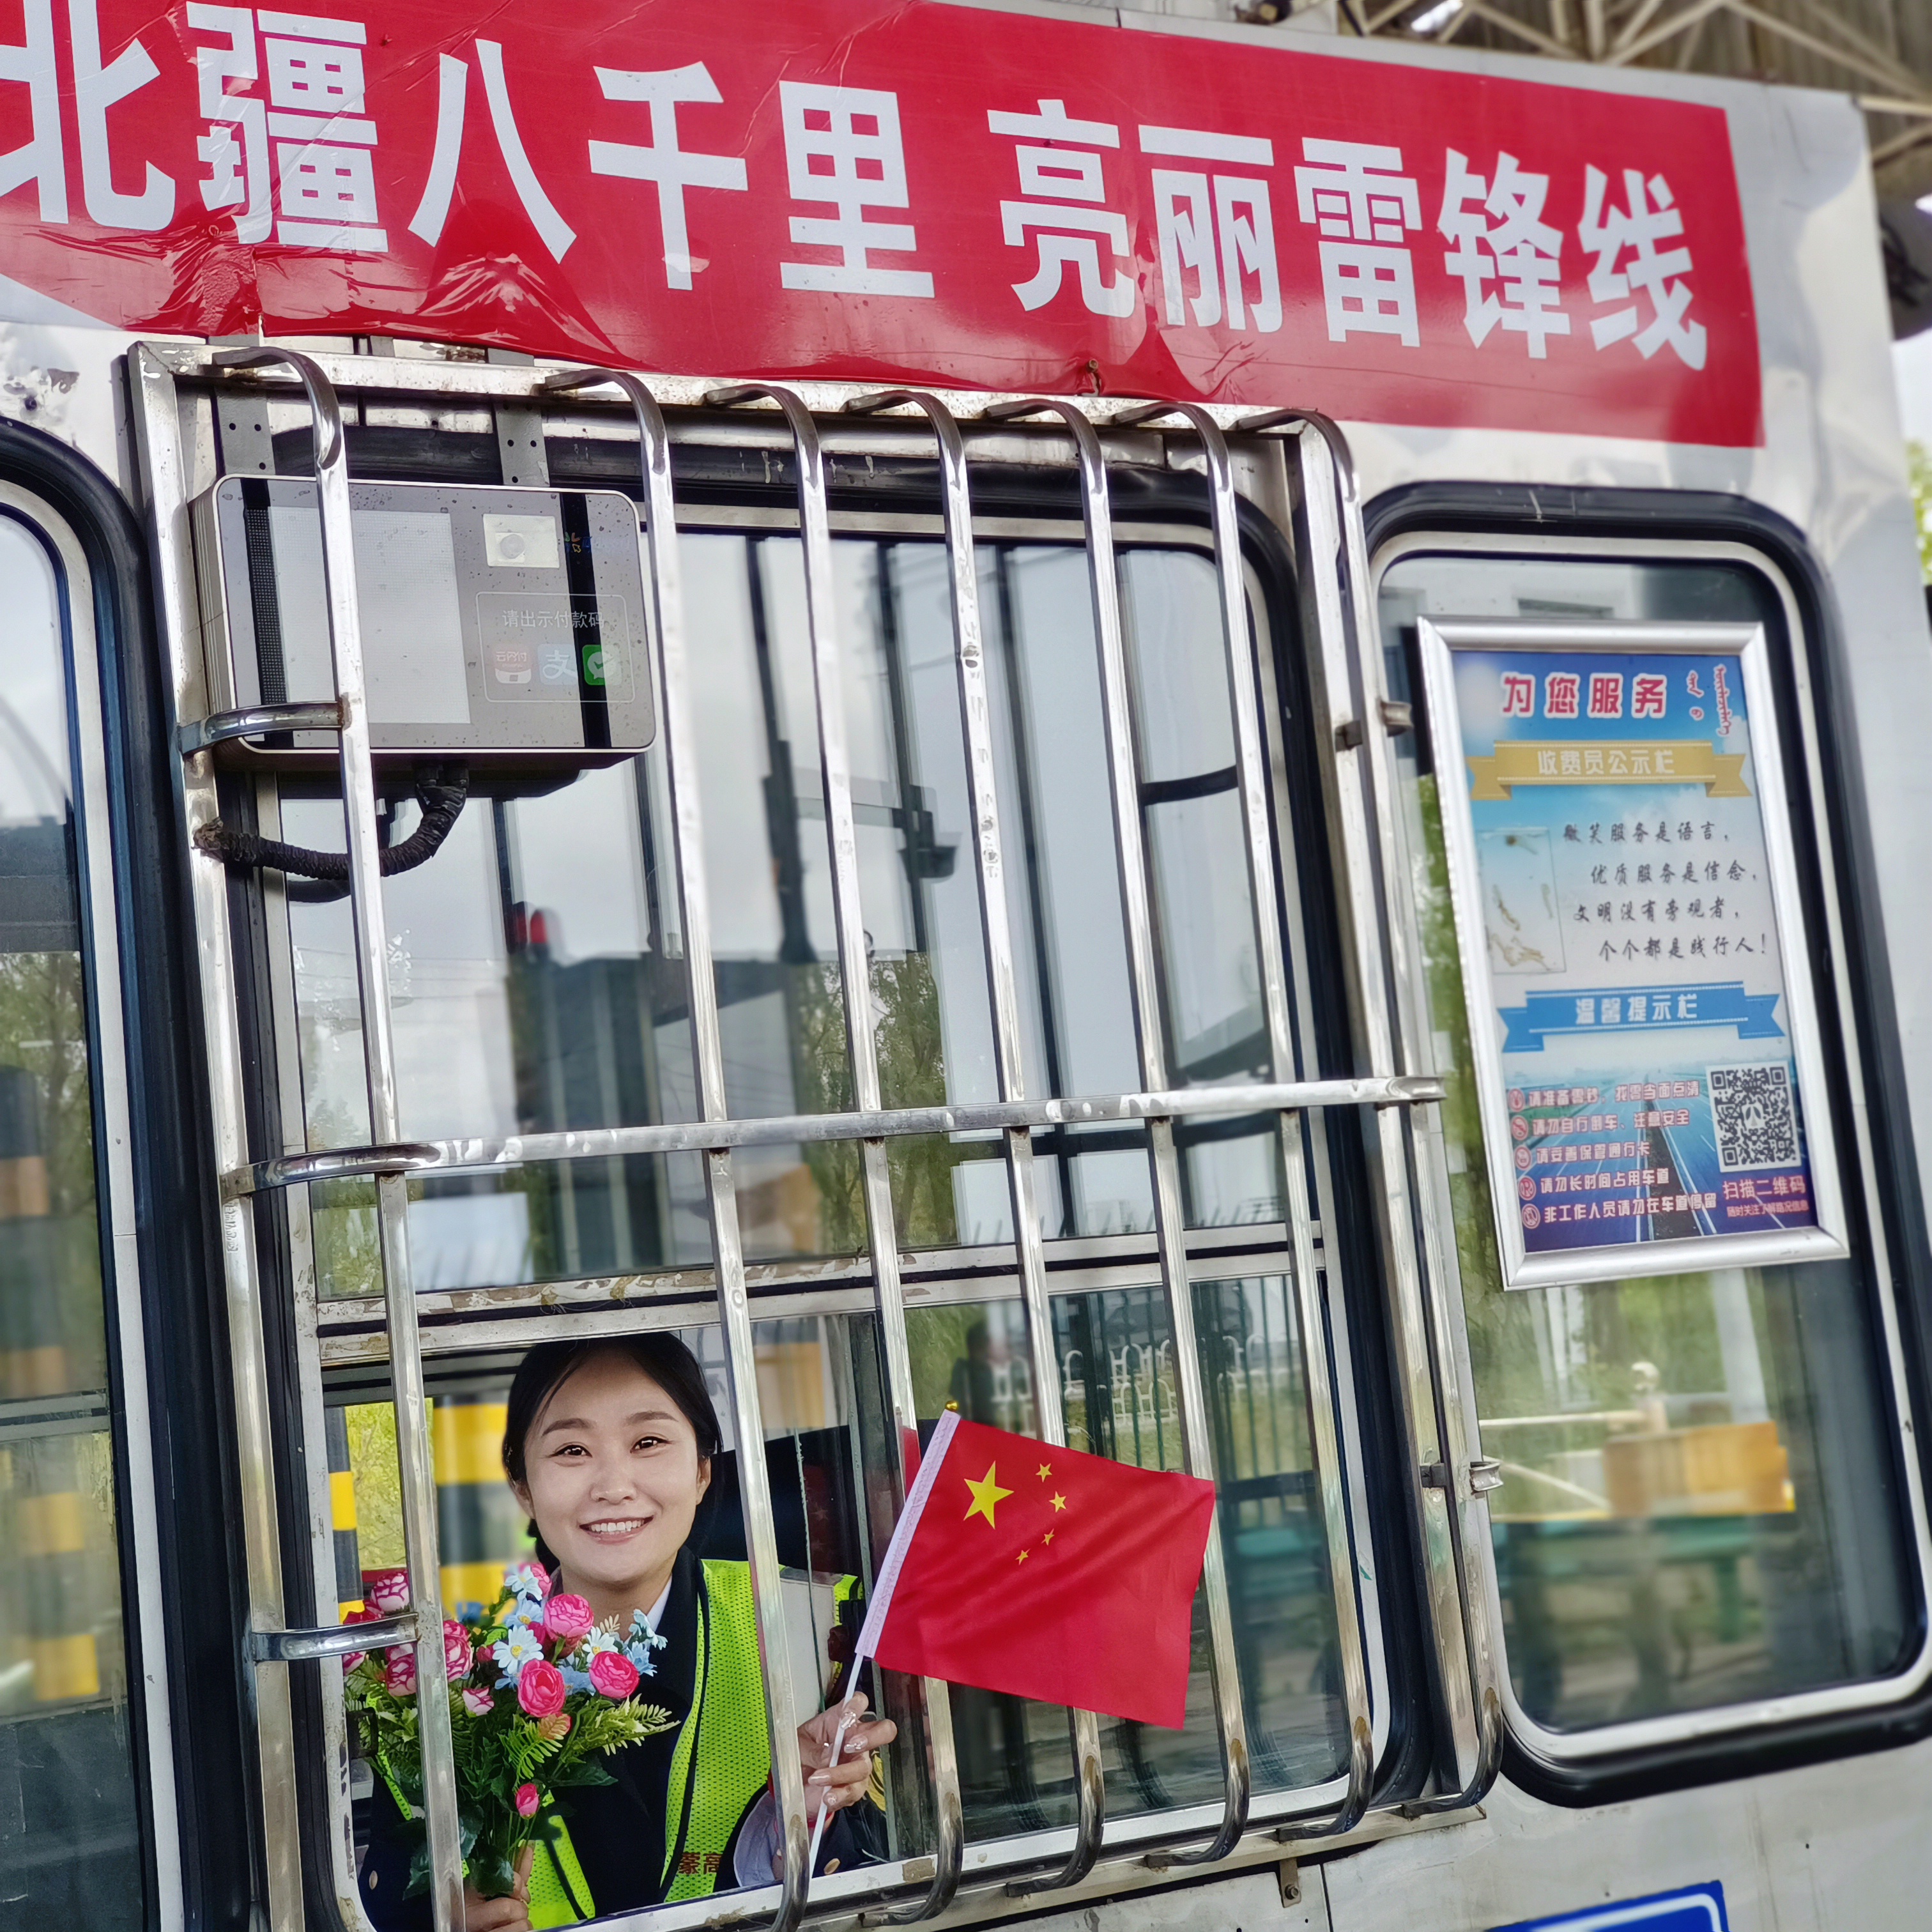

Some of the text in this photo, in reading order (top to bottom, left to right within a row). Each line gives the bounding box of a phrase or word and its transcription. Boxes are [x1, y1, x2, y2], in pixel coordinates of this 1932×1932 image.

[0, 0, 1707, 371] 北疆八千里 亮丽雷锋线
[502, 610, 606, 629] 请出示付款码
[1502, 675, 1666, 716] 为您服务
[1538, 749, 1675, 775] 收费员公示栏
[1575, 994, 1698, 1025] 温馨提示栏
[1537, 1142, 1650, 1164] 请妥善保管通行卡
[1540, 1169, 1669, 1193] 请勿长时间占用车道
[1723, 1176, 1806, 1199] 扫描二维码
[1544, 1193, 1717, 1223] 非工作人员请勿在车道停留
